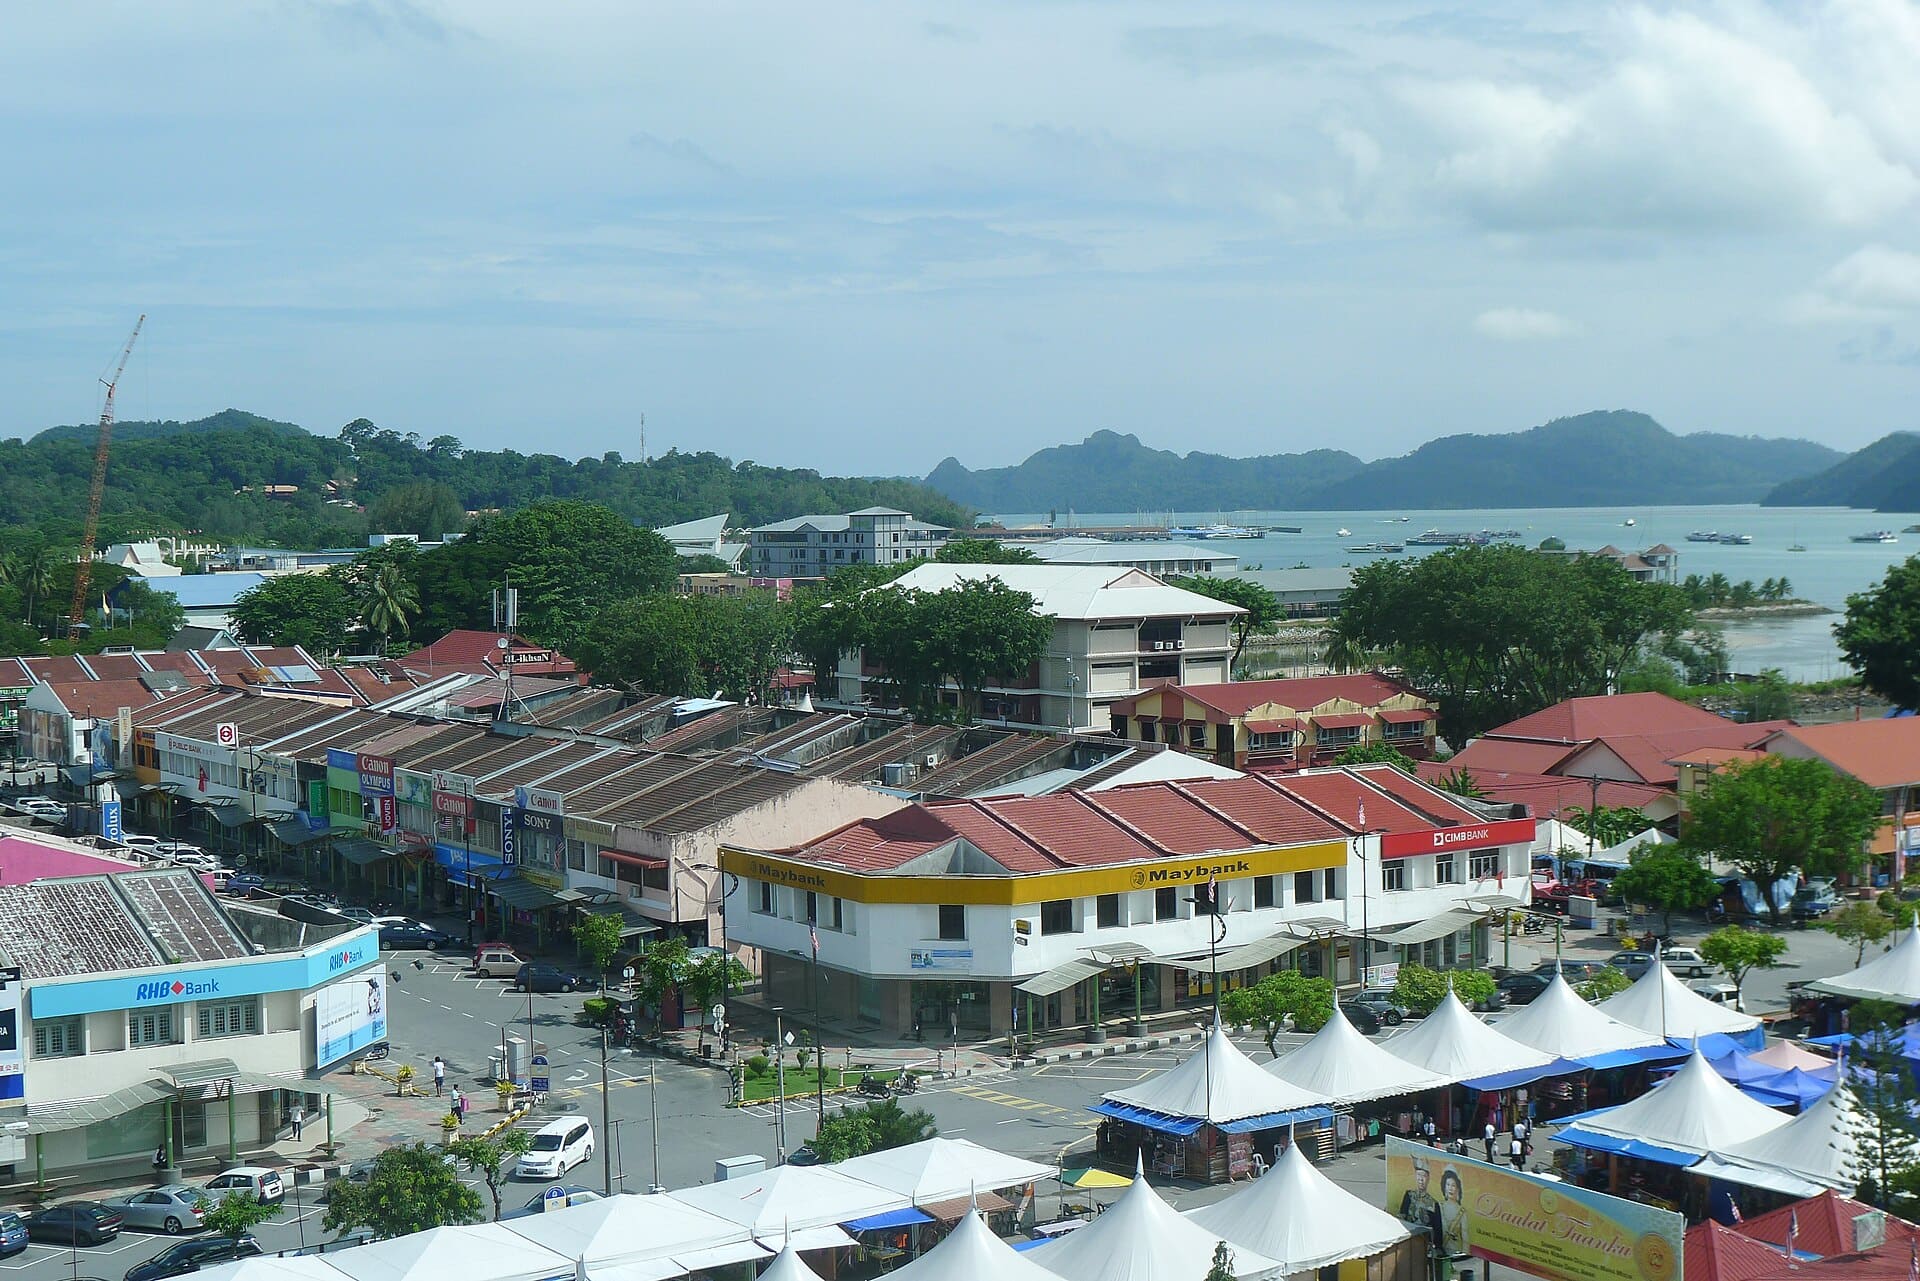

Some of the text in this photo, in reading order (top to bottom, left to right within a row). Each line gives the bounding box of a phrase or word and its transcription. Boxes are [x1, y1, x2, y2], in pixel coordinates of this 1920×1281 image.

[362, 755, 389, 774] Canon
[361, 773, 391, 789] OLYMPUS
[436, 794, 466, 815] Canon
[530, 793, 558, 810] Canon
[524, 814, 551, 830] SONY
[504, 816, 514, 864] SONY
[1444, 829, 1489, 843] CIMB BANK
[759, 863, 825, 887] Maybank
[1149, 860, 1250, 882] Maybank
[329, 946, 363, 971] RHB Bank
[136, 978, 220, 1001] RHB Bank
